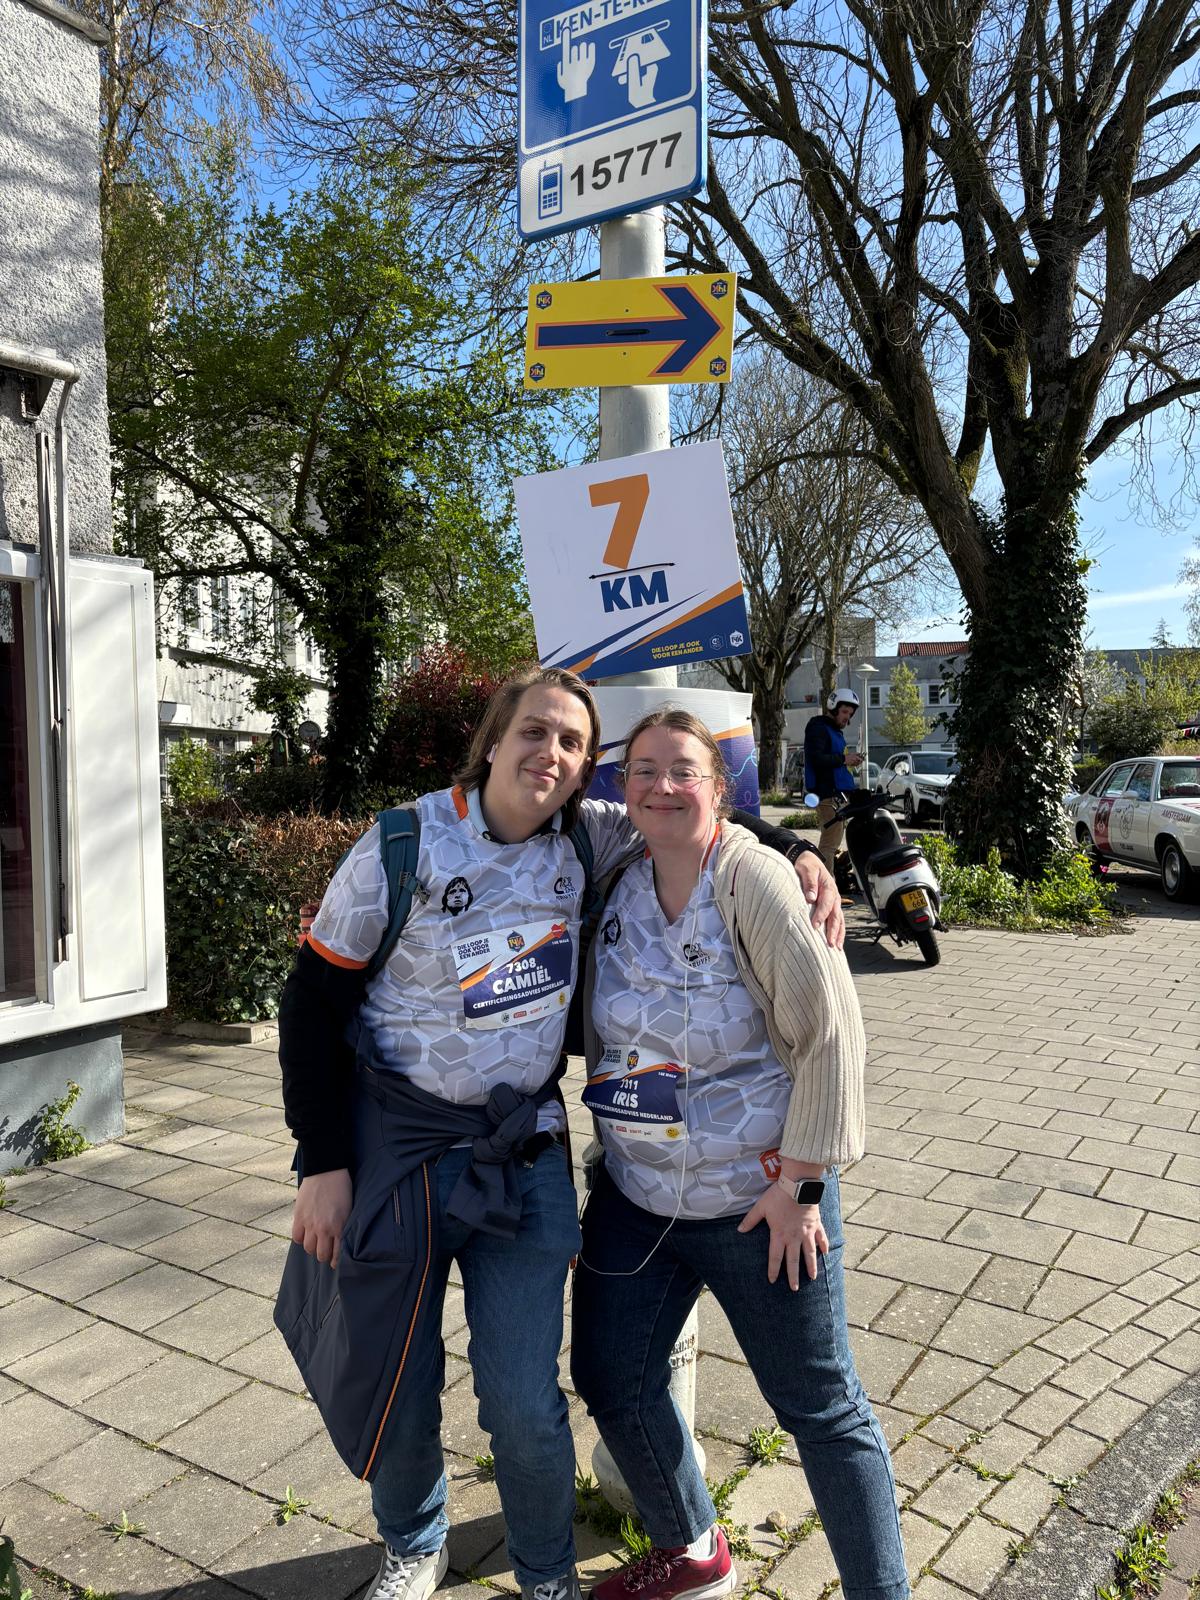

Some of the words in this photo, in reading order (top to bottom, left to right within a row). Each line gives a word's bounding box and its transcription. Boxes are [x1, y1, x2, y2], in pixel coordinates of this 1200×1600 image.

[543, 35, 553, 44] NL
[570, 131, 682, 197] 15777
[588, 473, 650, 570] 7
[600, 570, 670, 613] KM
[652, 652, 671, 660] VOOR
[683, 646, 704, 654] ANDER
[661, 644, 678, 652] LOOP
[686, 640, 700, 648] OOK
[1161, 808, 1192, 824] AMSTERDAM
[458, 947, 471, 955] OOK
[472, 943, 489, 951] VOOR
[467, 939, 483, 948] LOOP
[471, 948, 491, 957] ANDER
[506, 957, 537, 974] 7308
[492, 965, 551, 995] CAMIËL
[472, 988, 541, 1010] CERTIFICERINGSADVIES
[541, 979, 565, 992] NEDERLAND
[612, 1090, 639, 1109] IRIS
[639, 1112, 674, 1121] NEDERLAND
